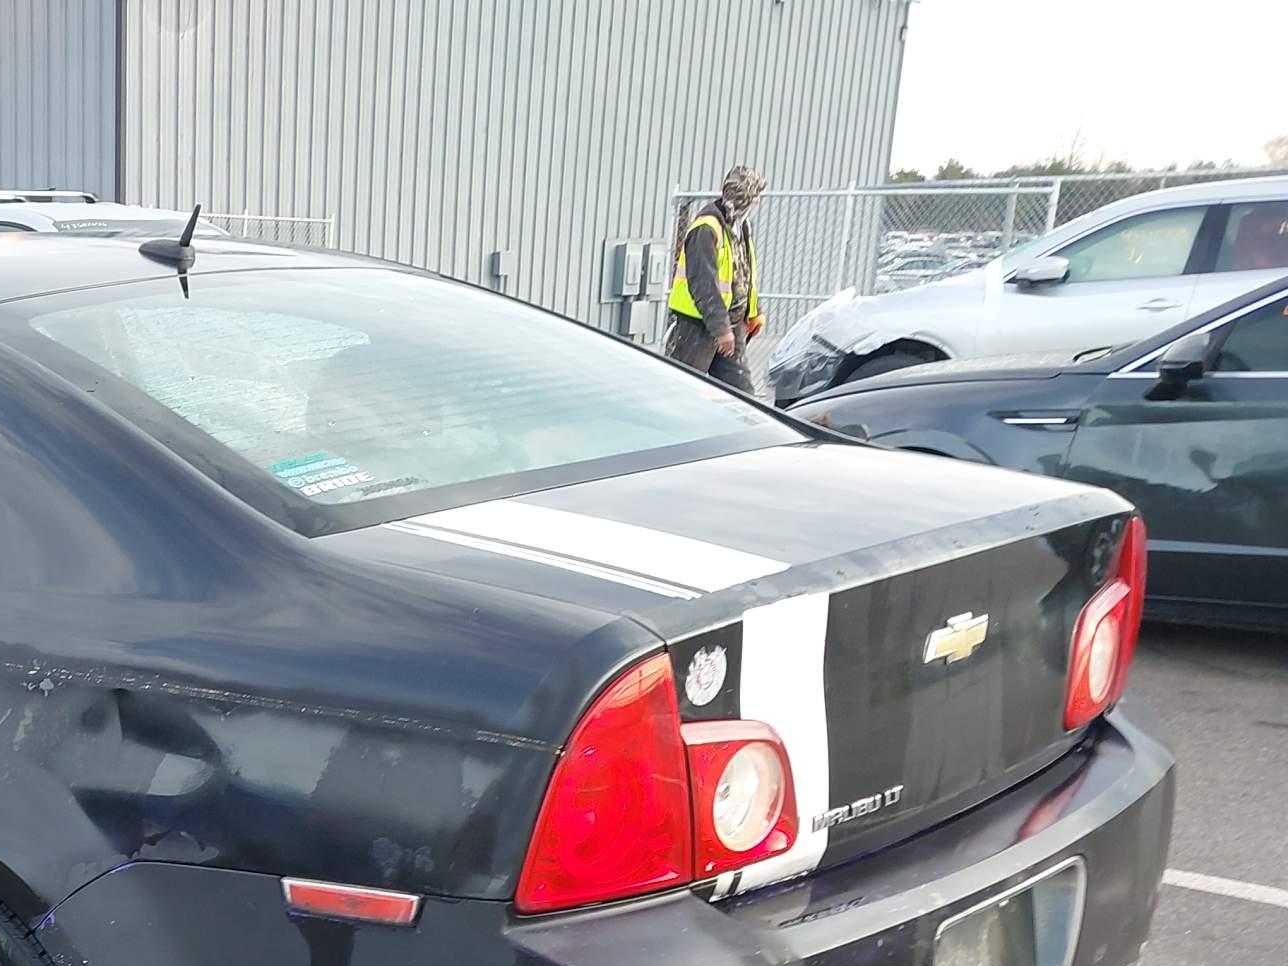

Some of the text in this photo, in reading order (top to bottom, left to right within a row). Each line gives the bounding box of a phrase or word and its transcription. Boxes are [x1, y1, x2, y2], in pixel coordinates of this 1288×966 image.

[299, 471, 375, 497] BRIDE
[811, 784, 904, 834] MALIBU LT
